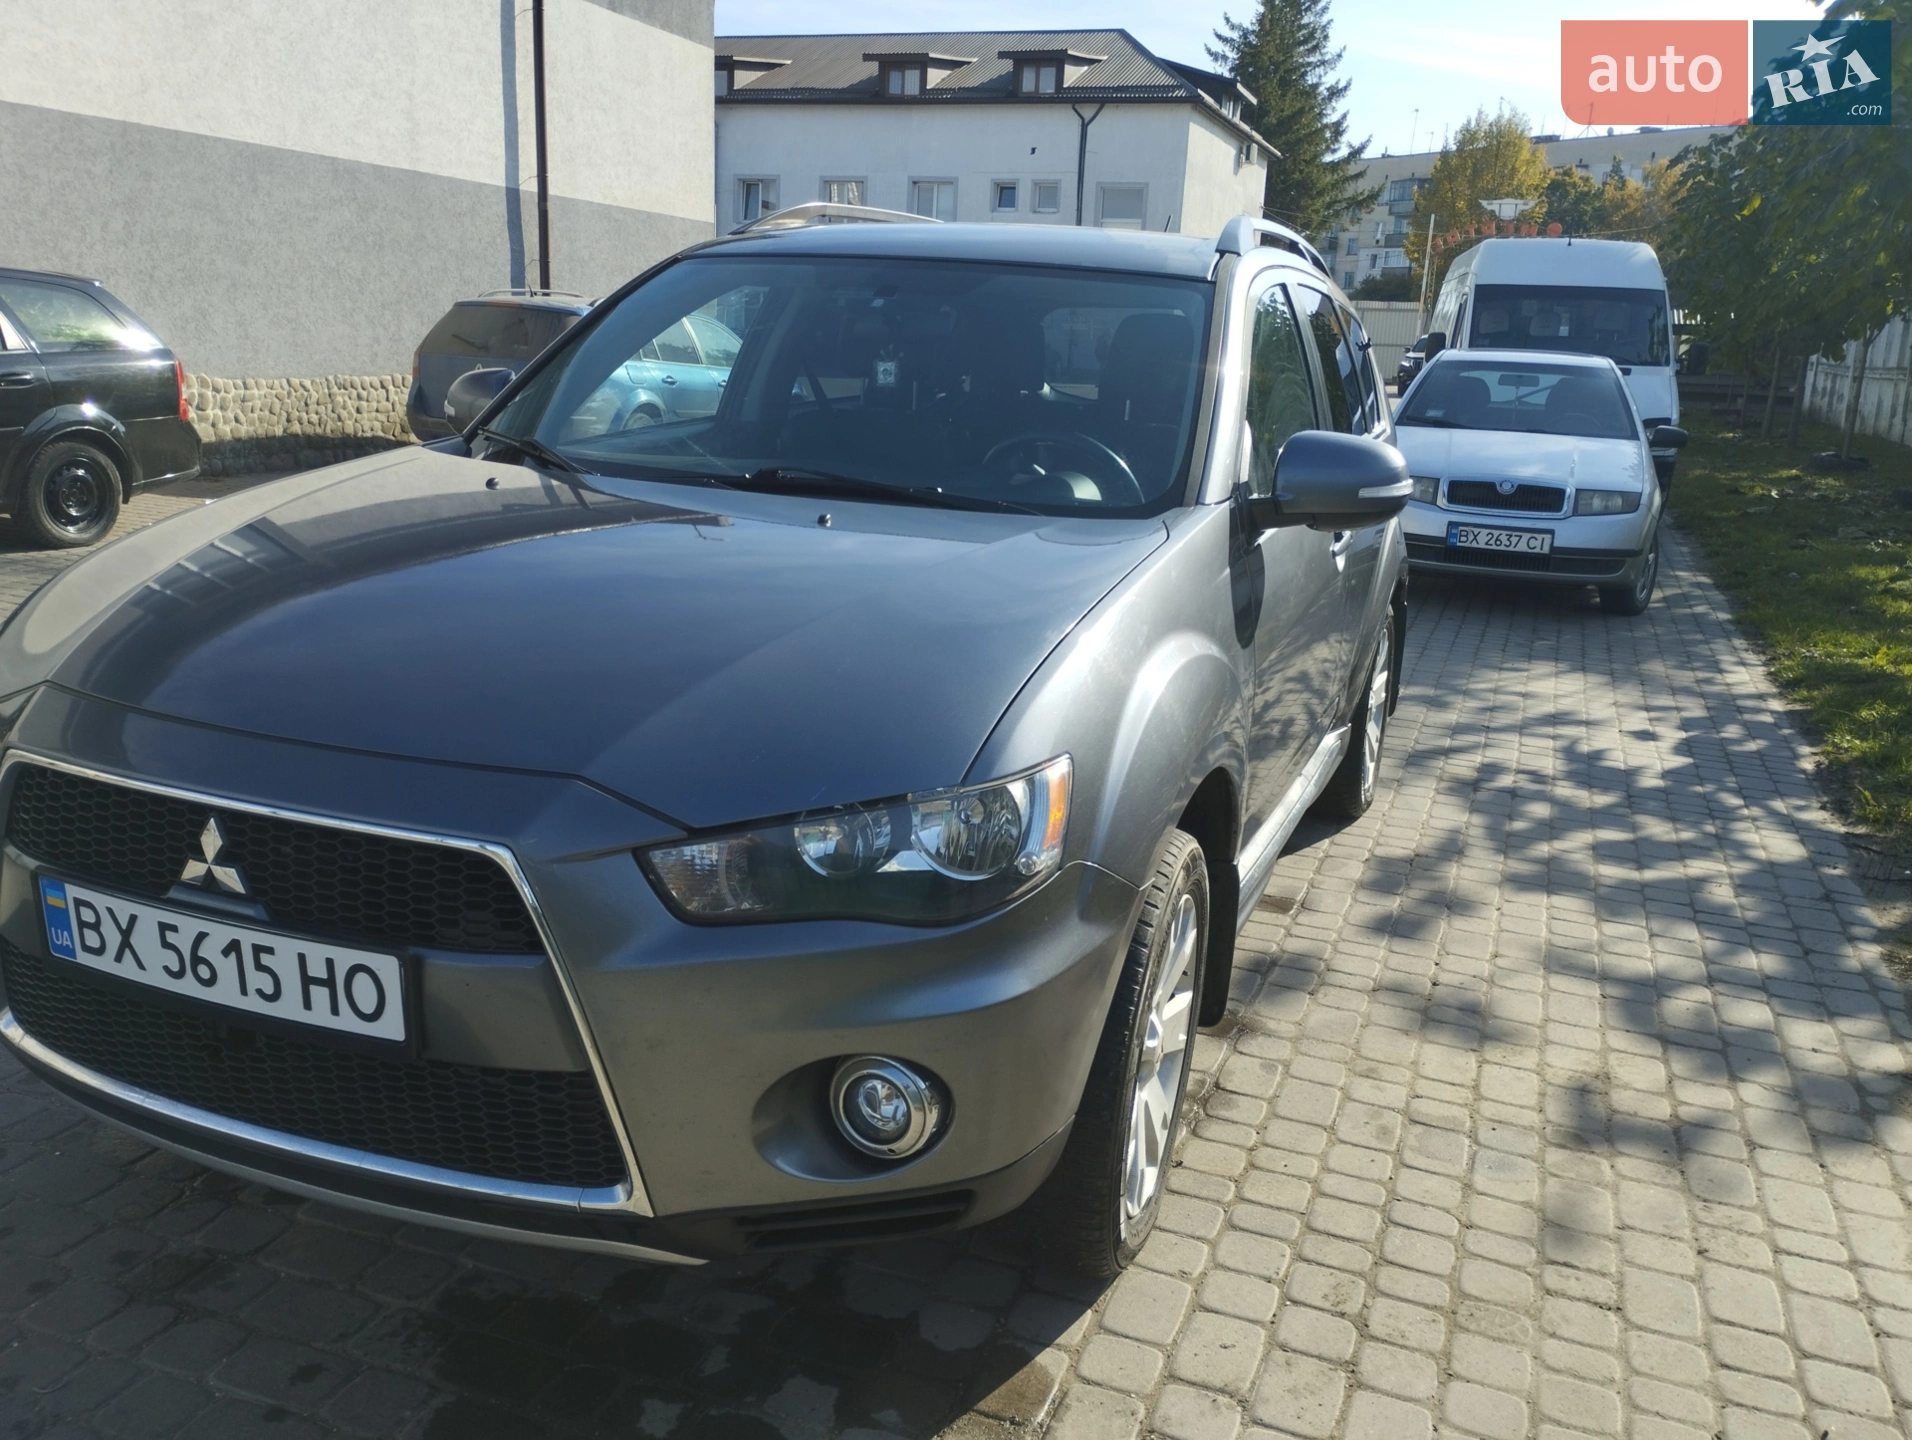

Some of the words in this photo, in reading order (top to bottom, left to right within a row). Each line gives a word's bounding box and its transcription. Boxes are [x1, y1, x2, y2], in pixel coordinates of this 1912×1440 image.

[1458, 529, 1482, 545] BX
[1484, 531, 1523, 549] 2637
[1526, 536, 1545, 551] CI
[52, 927, 73, 949] UA
[72, 896, 147, 972] BX
[157, 920, 282, 1003] 5615
[297, 951, 386, 1023] HO
